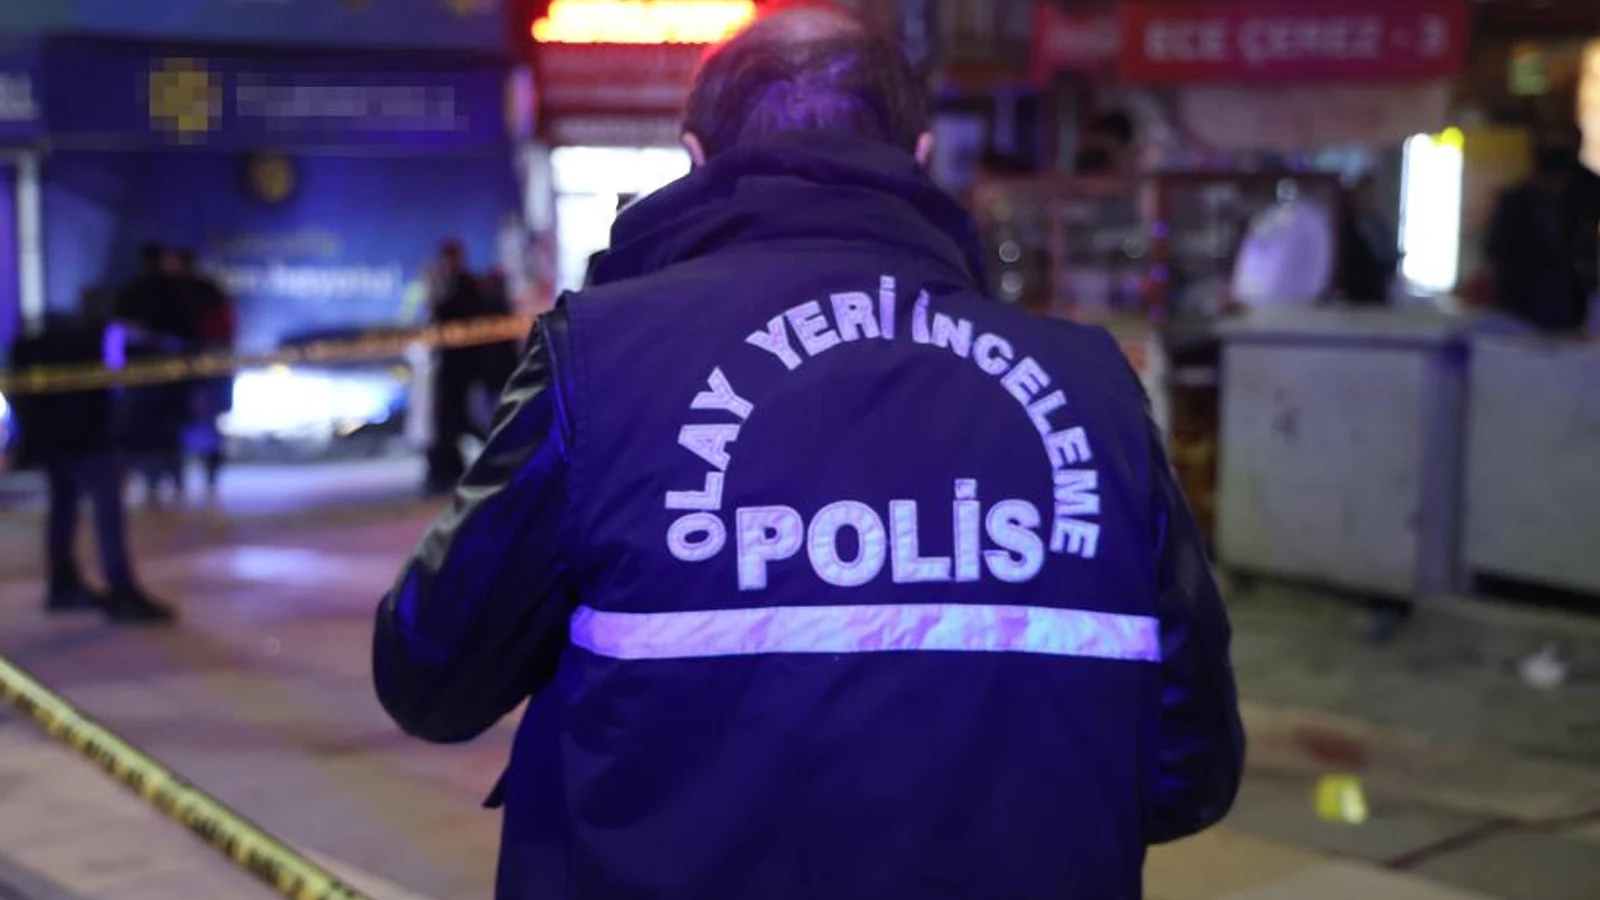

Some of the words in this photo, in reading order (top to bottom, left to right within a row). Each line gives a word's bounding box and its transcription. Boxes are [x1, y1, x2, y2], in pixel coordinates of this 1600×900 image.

[665, 367, 754, 562] OLAY
[745, 275, 896, 370] YERİ
[912, 289, 1100, 558] İNCELEME
[736, 478, 1045, 591] POLİS
